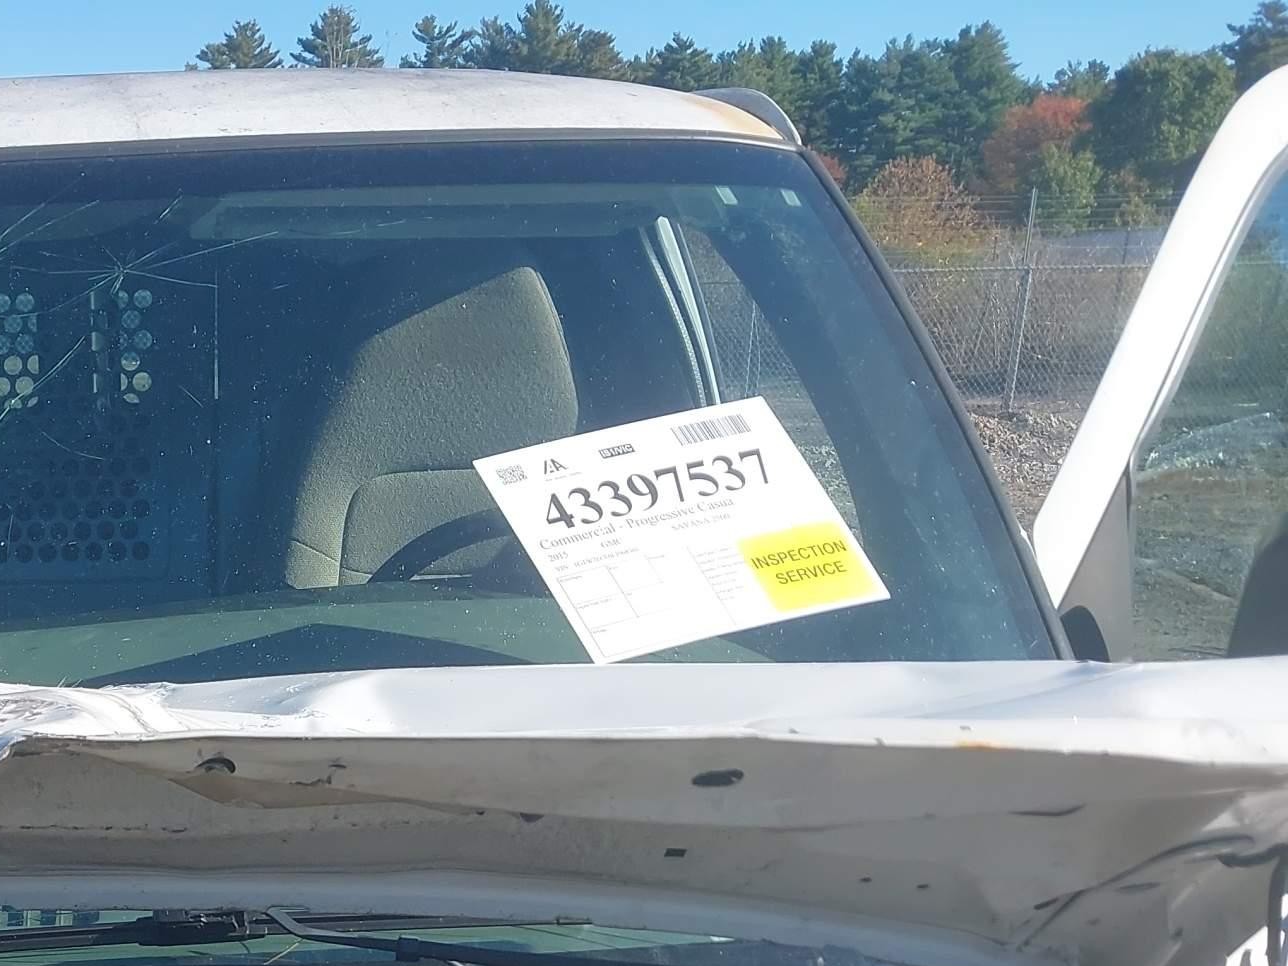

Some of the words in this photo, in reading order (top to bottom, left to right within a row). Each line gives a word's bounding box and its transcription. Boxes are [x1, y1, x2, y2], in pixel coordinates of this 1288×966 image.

[545, 448, 770, 529] 43397537
[539, 522, 616, 550] Commercial
[625, 506, 695, 530] Progressive
[750, 540, 847, 570] INSPECTION
[775, 560, 848, 585] SERVICE
